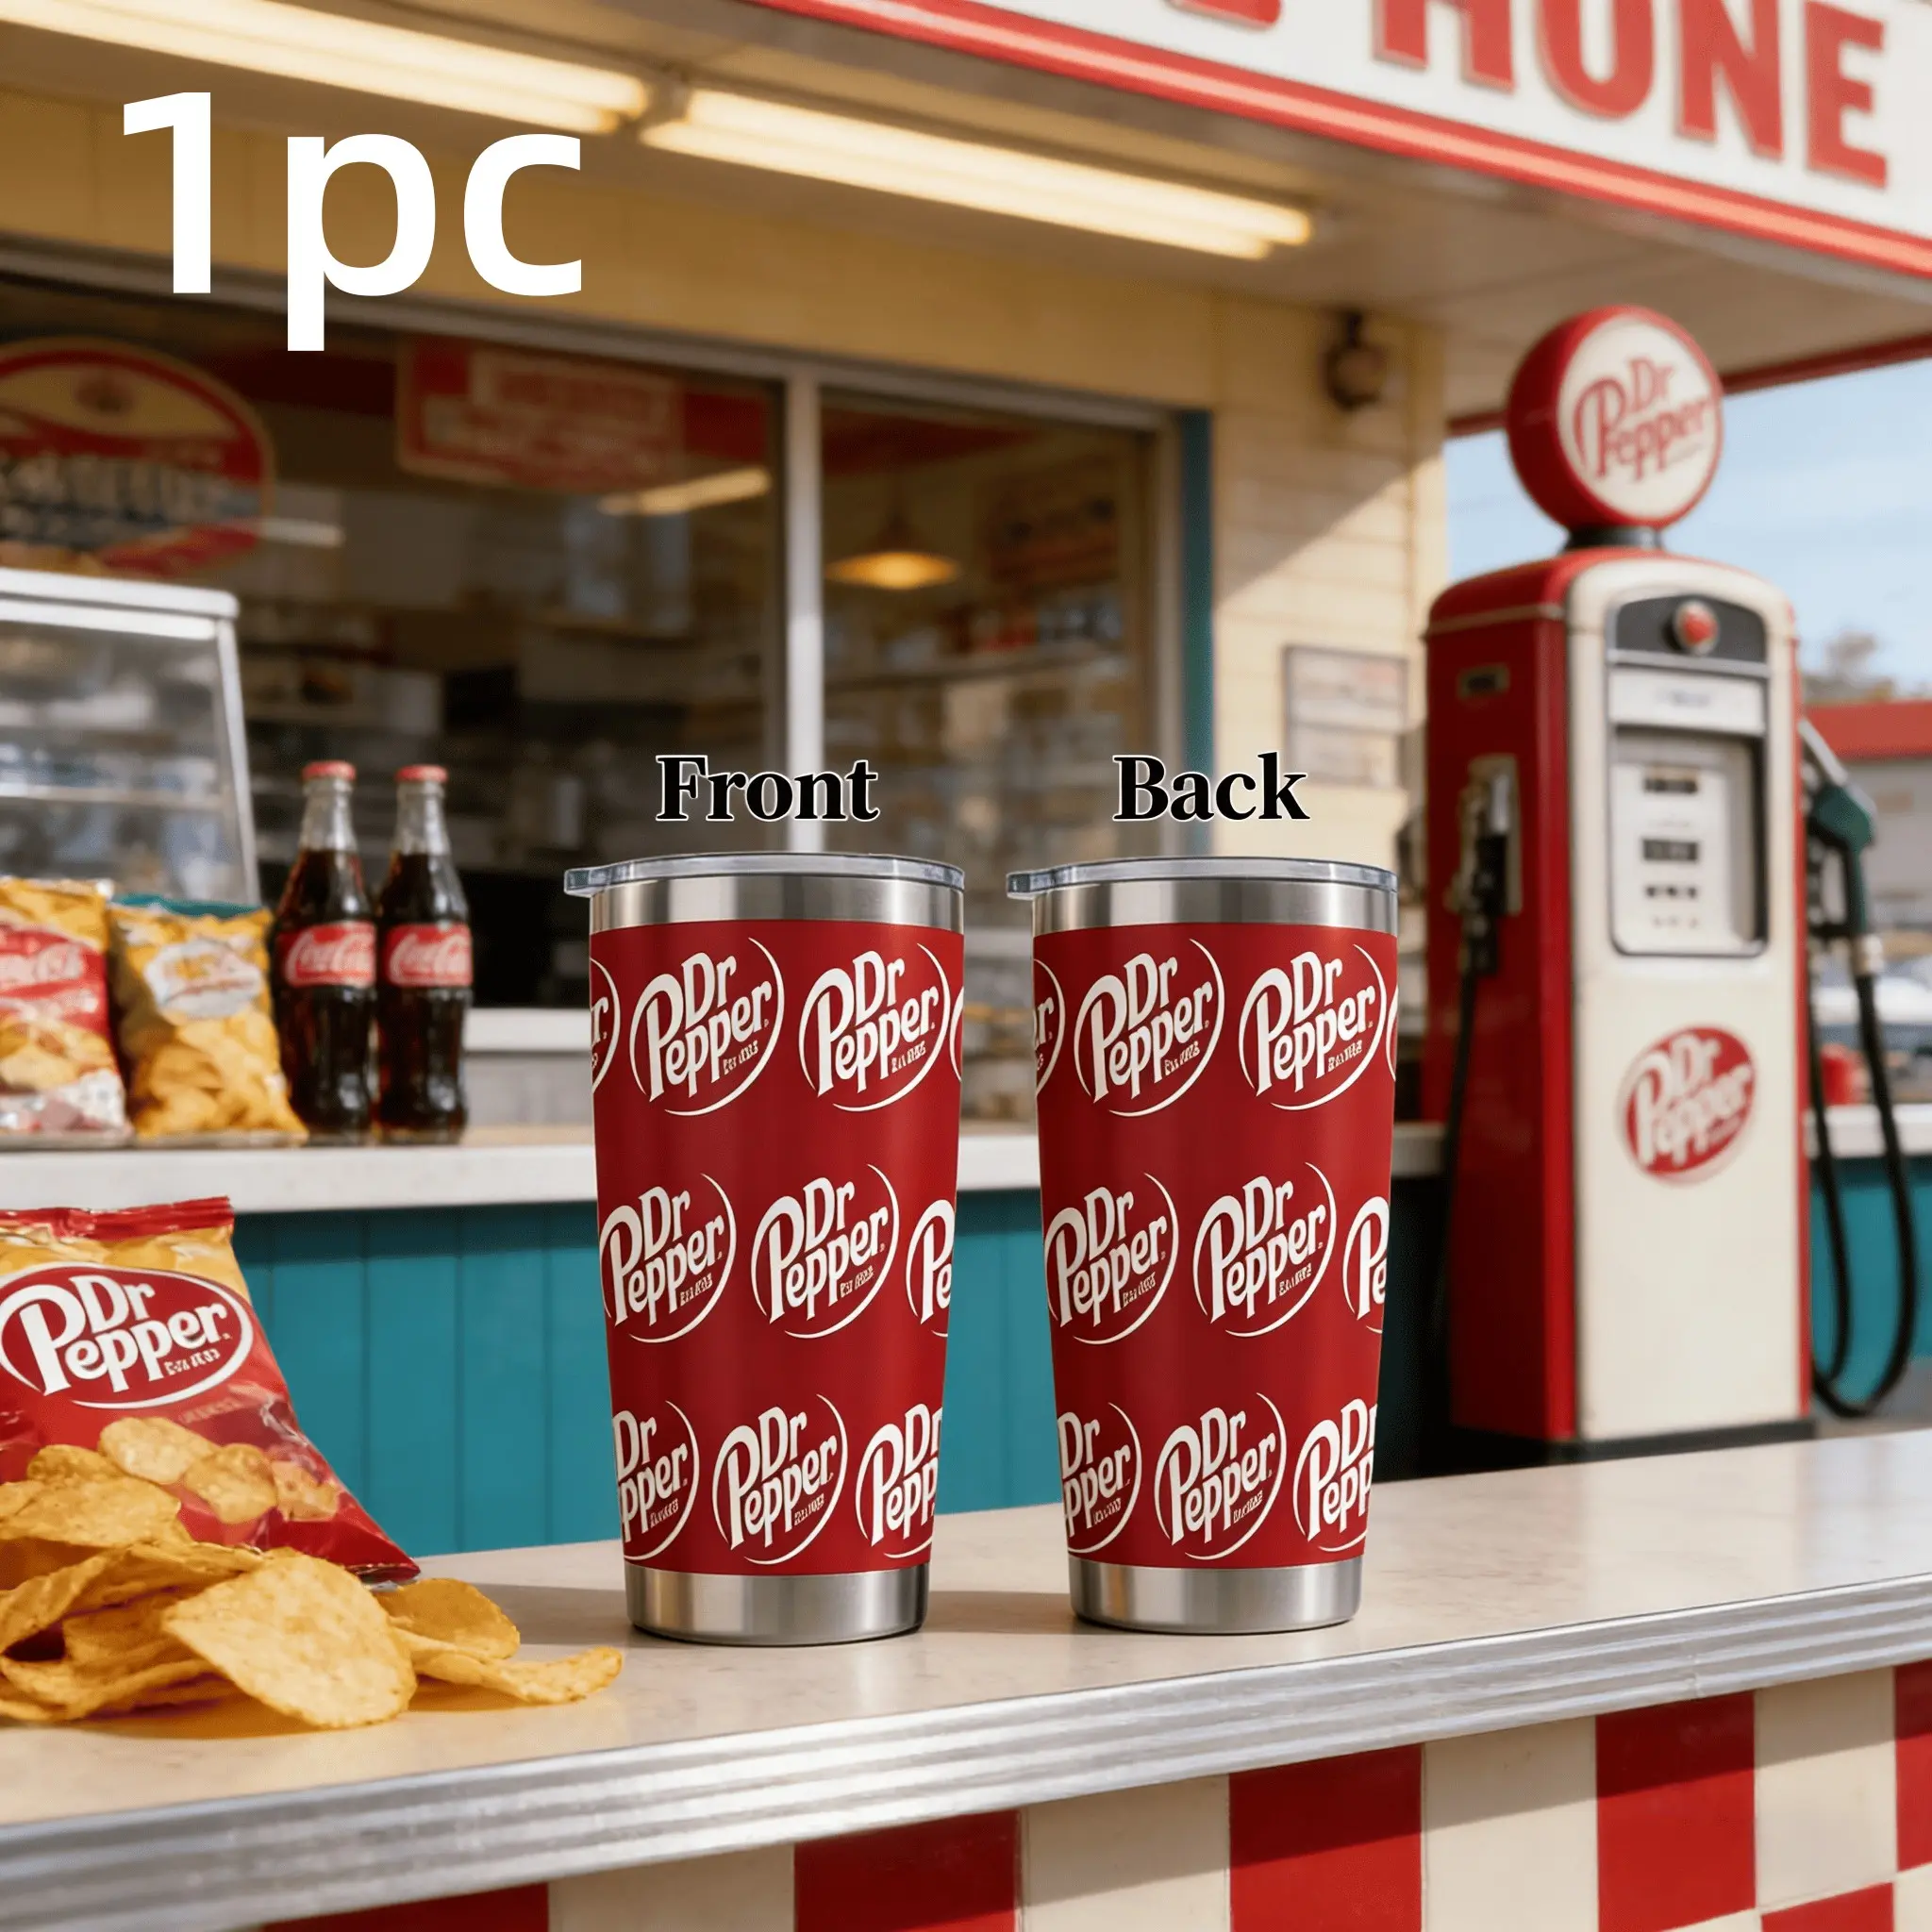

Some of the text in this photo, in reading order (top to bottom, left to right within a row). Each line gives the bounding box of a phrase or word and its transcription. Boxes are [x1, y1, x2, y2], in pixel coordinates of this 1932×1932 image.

[682, 952, 736, 1028] Dr
[853, 951, 905, 1025] Dr
[1124, 953, 1178, 1029] Dr
[1291, 951, 1342, 1025] Dr
[629, 974, 772, 1102] Pepper
[799, 968, 939, 1097] Pepper
[1074, 974, 1212, 1104] Pepper
[1239, 968, 1375, 1097] Pepper
[639, 1187, 690, 1260] Dr
[804, 1177, 855, 1252] Dr
[1084, 1187, 1134, 1260] Dr
[1242, 1175, 1293, 1250] Dr
[600, 1206, 724, 1326] Pepper
[751, 1196, 888, 1324] Pepper
[1044, 1207, 1167, 1327] Pepper
[1193, 1195, 1326, 1324] Pepper
[0, 1285, 228, 1396] Pepper
[70, 1275, 156, 1332] Dr
[613, 1410, 657, 1482] Dr
[758, 1407, 807, 1481] Dr
[1058, 1412, 1100, 1479] Dr
[1201, 1407, 1246, 1480] Dr
[712, 1424, 837, 1550] Pepper
[1154, 1424, 1276, 1546] Pepper
